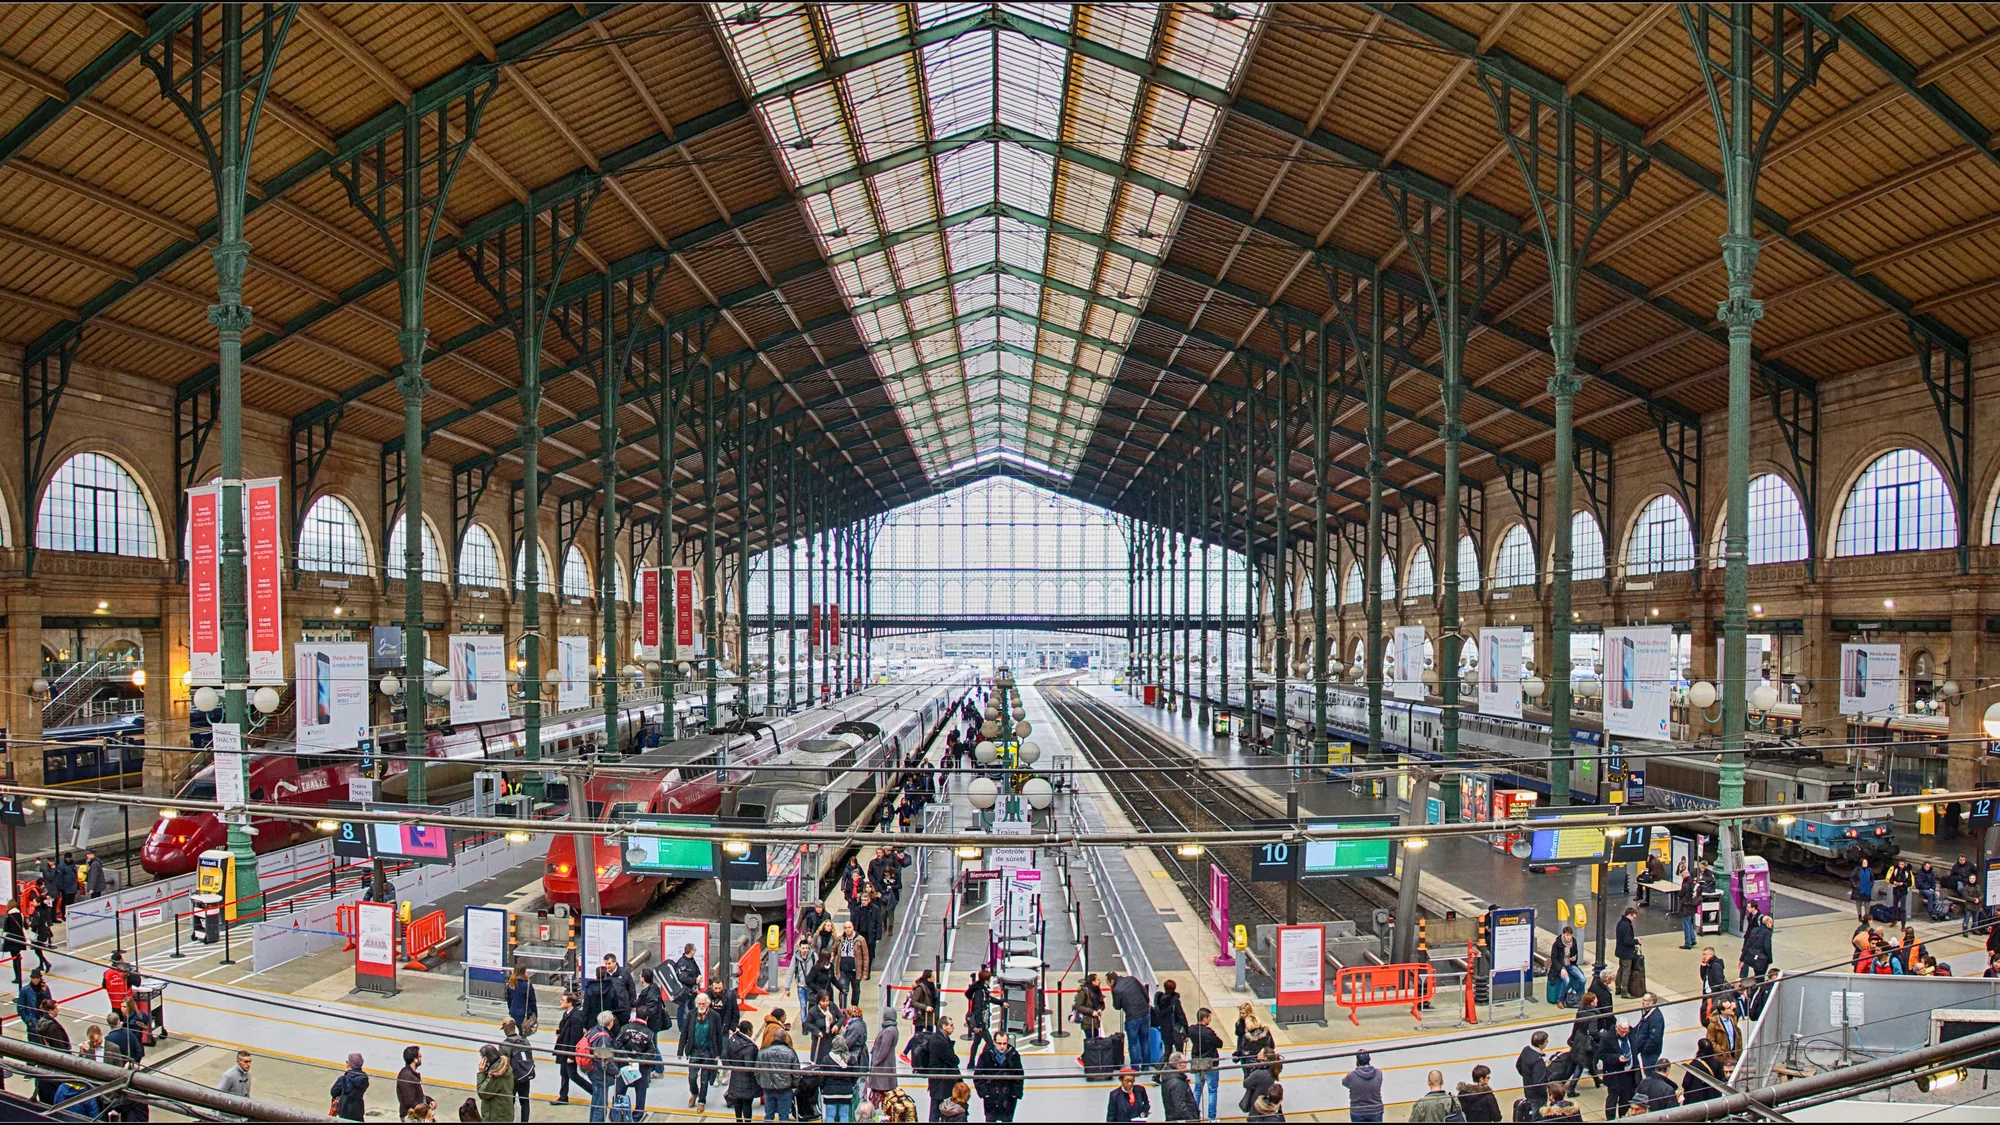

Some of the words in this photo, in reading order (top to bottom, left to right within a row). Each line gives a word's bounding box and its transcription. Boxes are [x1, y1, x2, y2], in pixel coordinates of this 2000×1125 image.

[1990, 740, 2000, 751] 12
[301, 778, 327, 792] THALYS
[1665, 794, 1676, 807] en
[1976, 800, 1990, 814] 12
[342, 823, 354, 840] 8
[1626, 827, 1644, 845] 11
[1262, 843, 1288, 862] 10
[201, 859, 217, 867] Accueil
